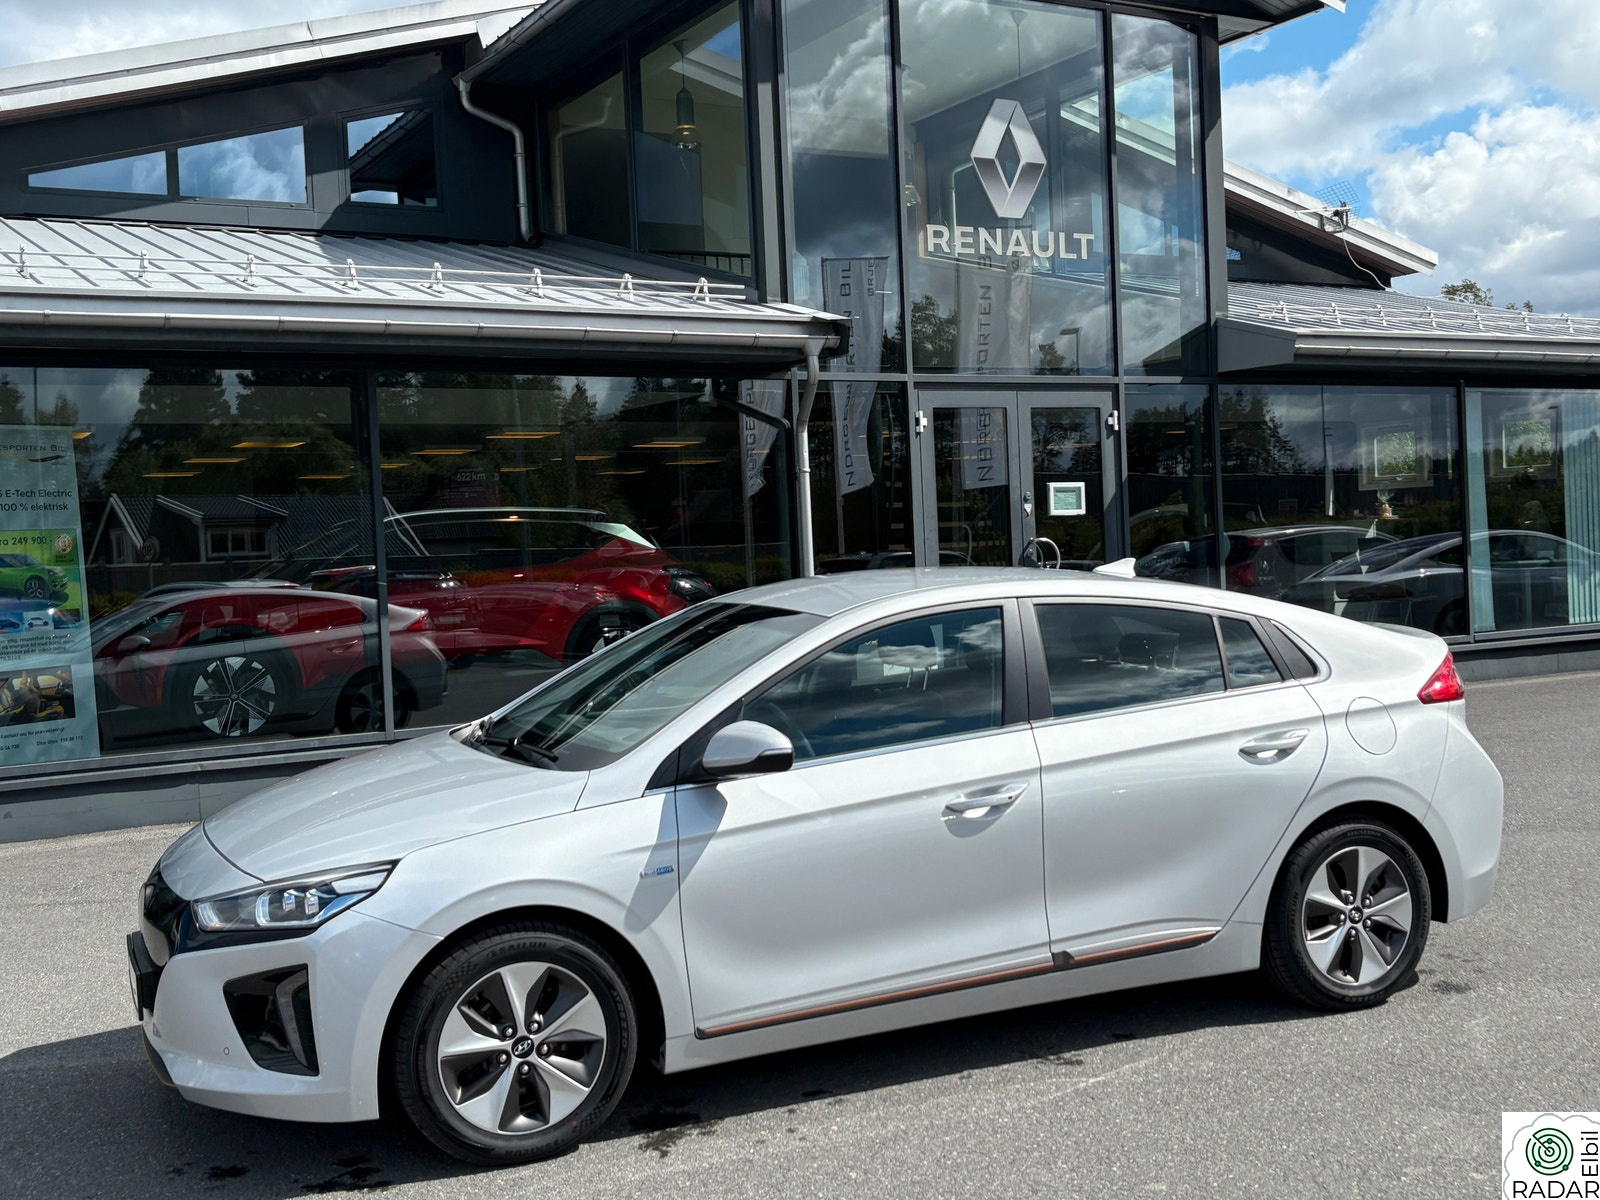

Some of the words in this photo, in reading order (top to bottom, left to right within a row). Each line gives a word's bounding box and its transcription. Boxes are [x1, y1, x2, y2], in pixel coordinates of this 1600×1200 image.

[926, 224, 1095, 260] RENAULT
[840, 261, 852, 296] BIL
[5, 489, 36, 498] E-Tech
[38, 488, 73, 498] Electric
[0, 503, 17, 511] 100
[31, 502, 69, 511] elektrisk
[12, 537, 28, 546] 249
